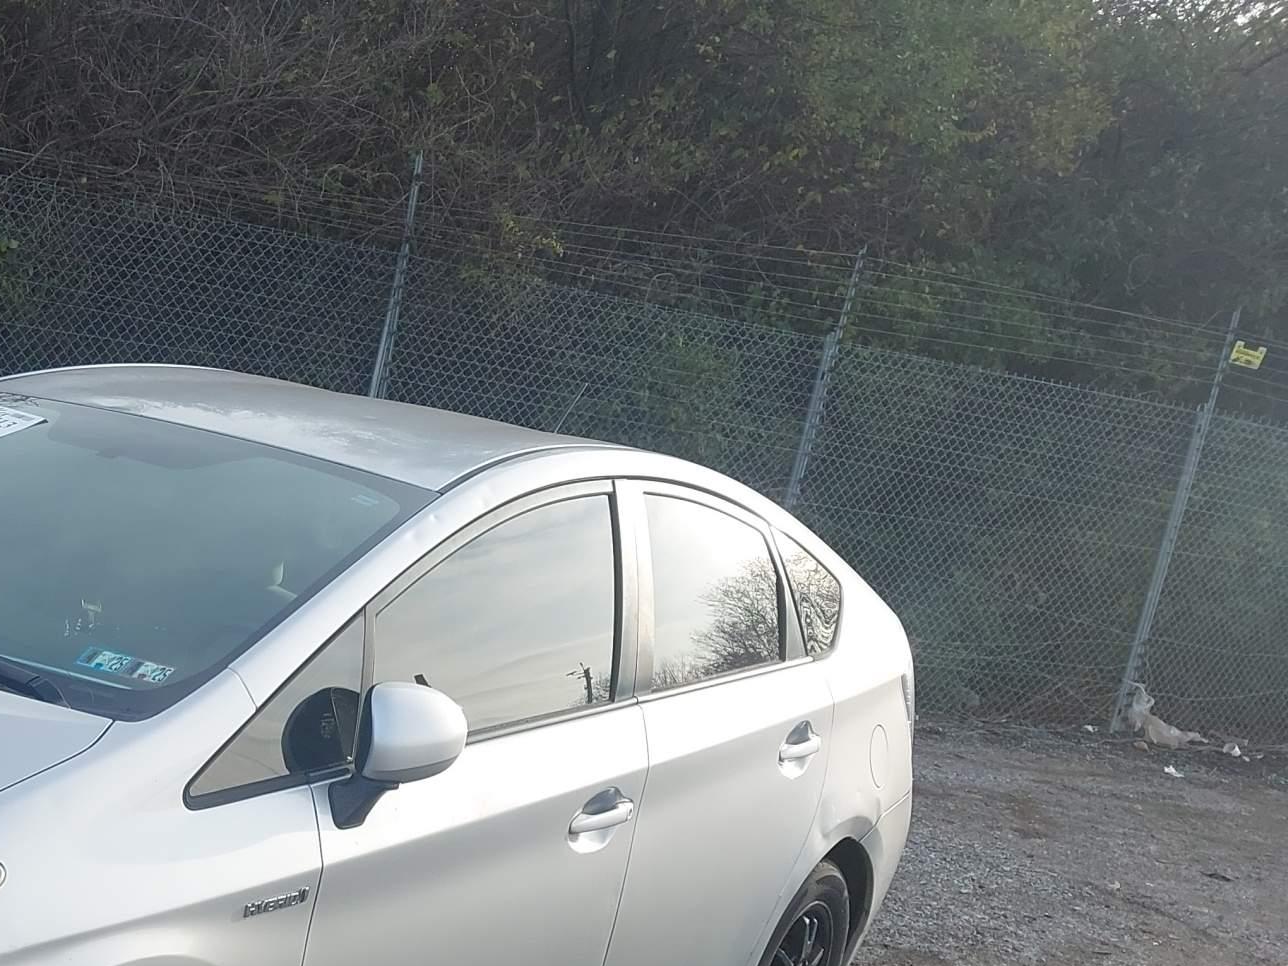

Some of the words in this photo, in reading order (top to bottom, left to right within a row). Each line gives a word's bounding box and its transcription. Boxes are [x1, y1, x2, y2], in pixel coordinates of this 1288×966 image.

[108, 656, 129, 672] 25
[151, 667, 173, 683] 25
[243, 891, 302, 918] HYBRID
